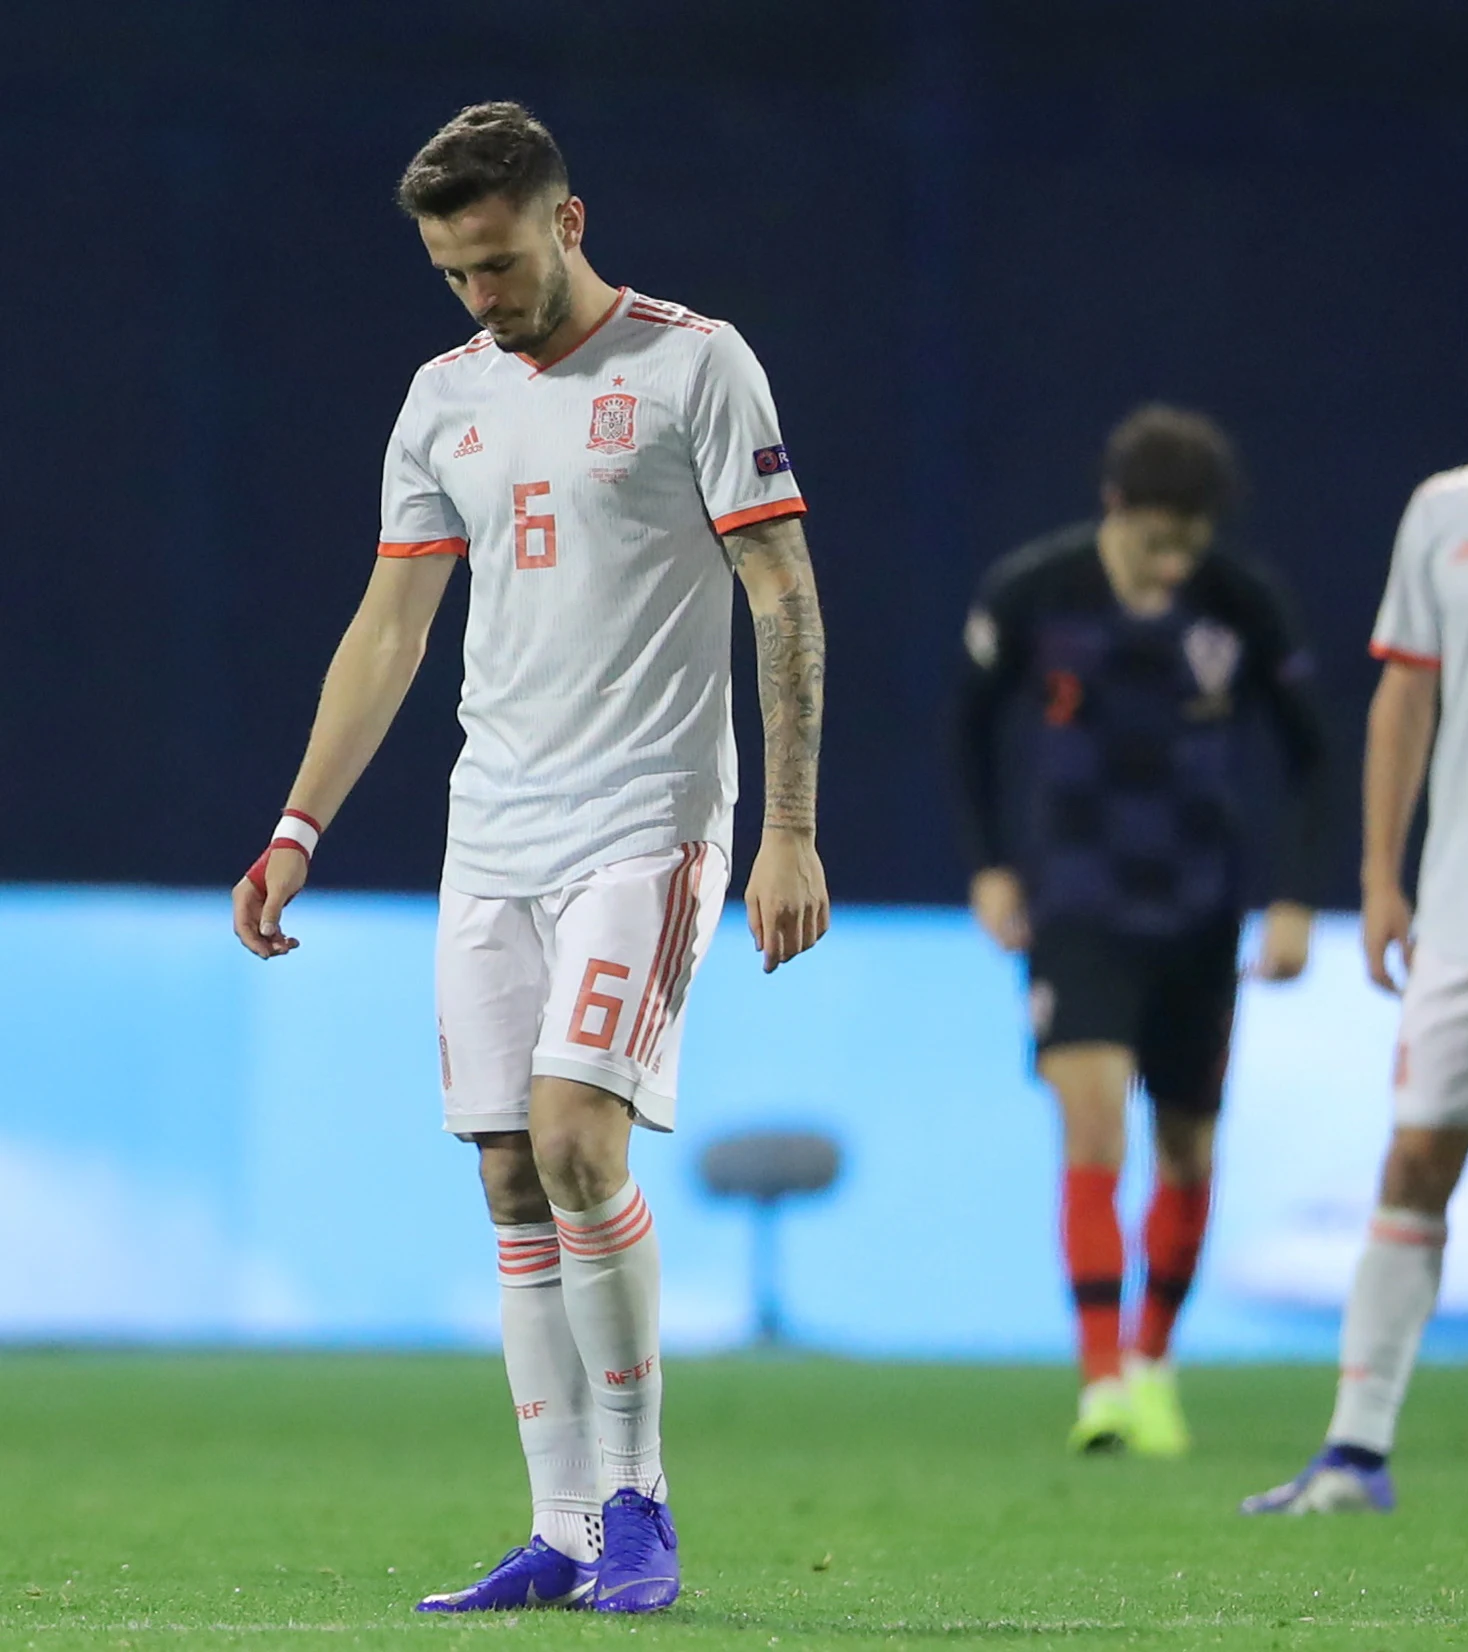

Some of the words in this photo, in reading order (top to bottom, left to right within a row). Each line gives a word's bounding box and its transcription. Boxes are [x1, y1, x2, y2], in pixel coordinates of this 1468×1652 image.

[453, 443, 483, 459] adidas
[513, 481, 557, 570] 6
[566, 957, 631, 1050] 6
[604, 1355, 654, 1386] RFEF
